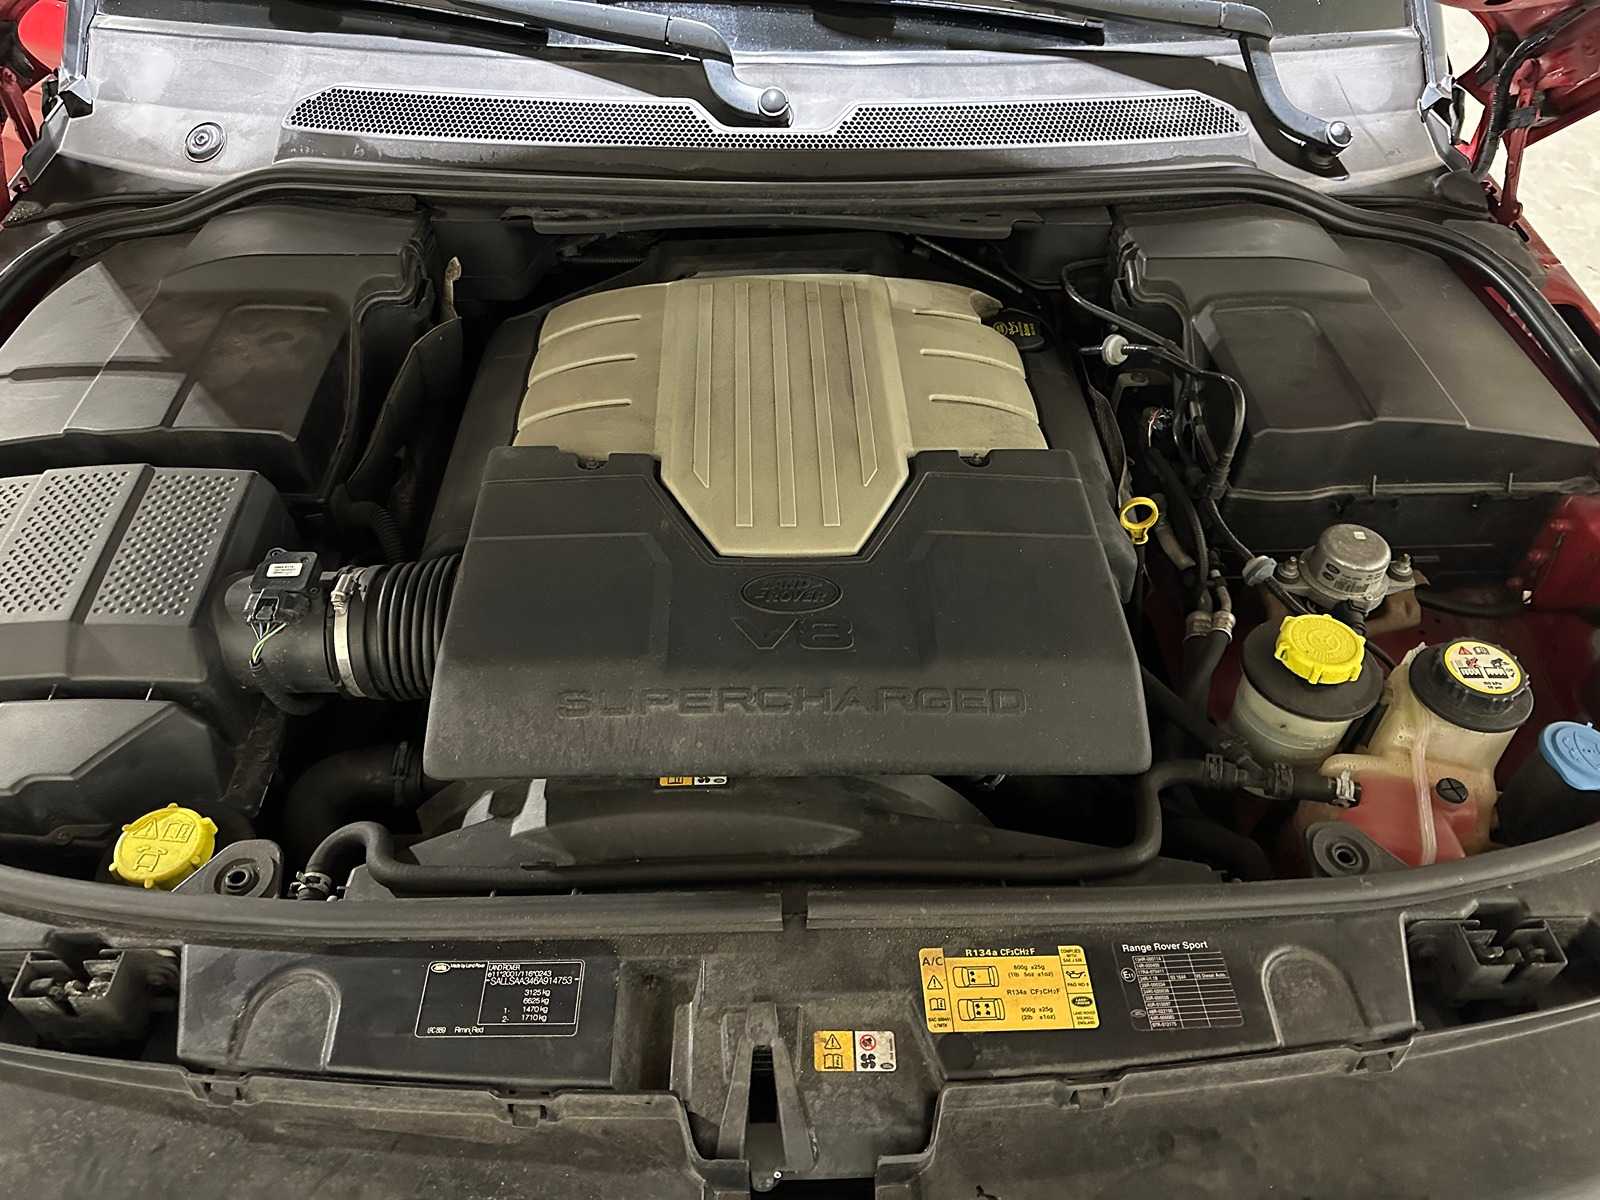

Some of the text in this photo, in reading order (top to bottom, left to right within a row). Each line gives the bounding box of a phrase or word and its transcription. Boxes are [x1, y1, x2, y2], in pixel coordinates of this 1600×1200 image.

[731, 616, 856, 651] V8
[556, 687, 1028, 721] SUPERCHARGED
[1121, 940, 1208, 954] Range Rover Sport
[965, 949, 998, 957] R134a
[922, 957, 943, 966] A/C
[542, 989, 551, 997] kg
[523, 997, 549, 1005] 6625 kg
[540, 1006, 548, 1014] kg
[538, 1014, 547, 1022] kg
